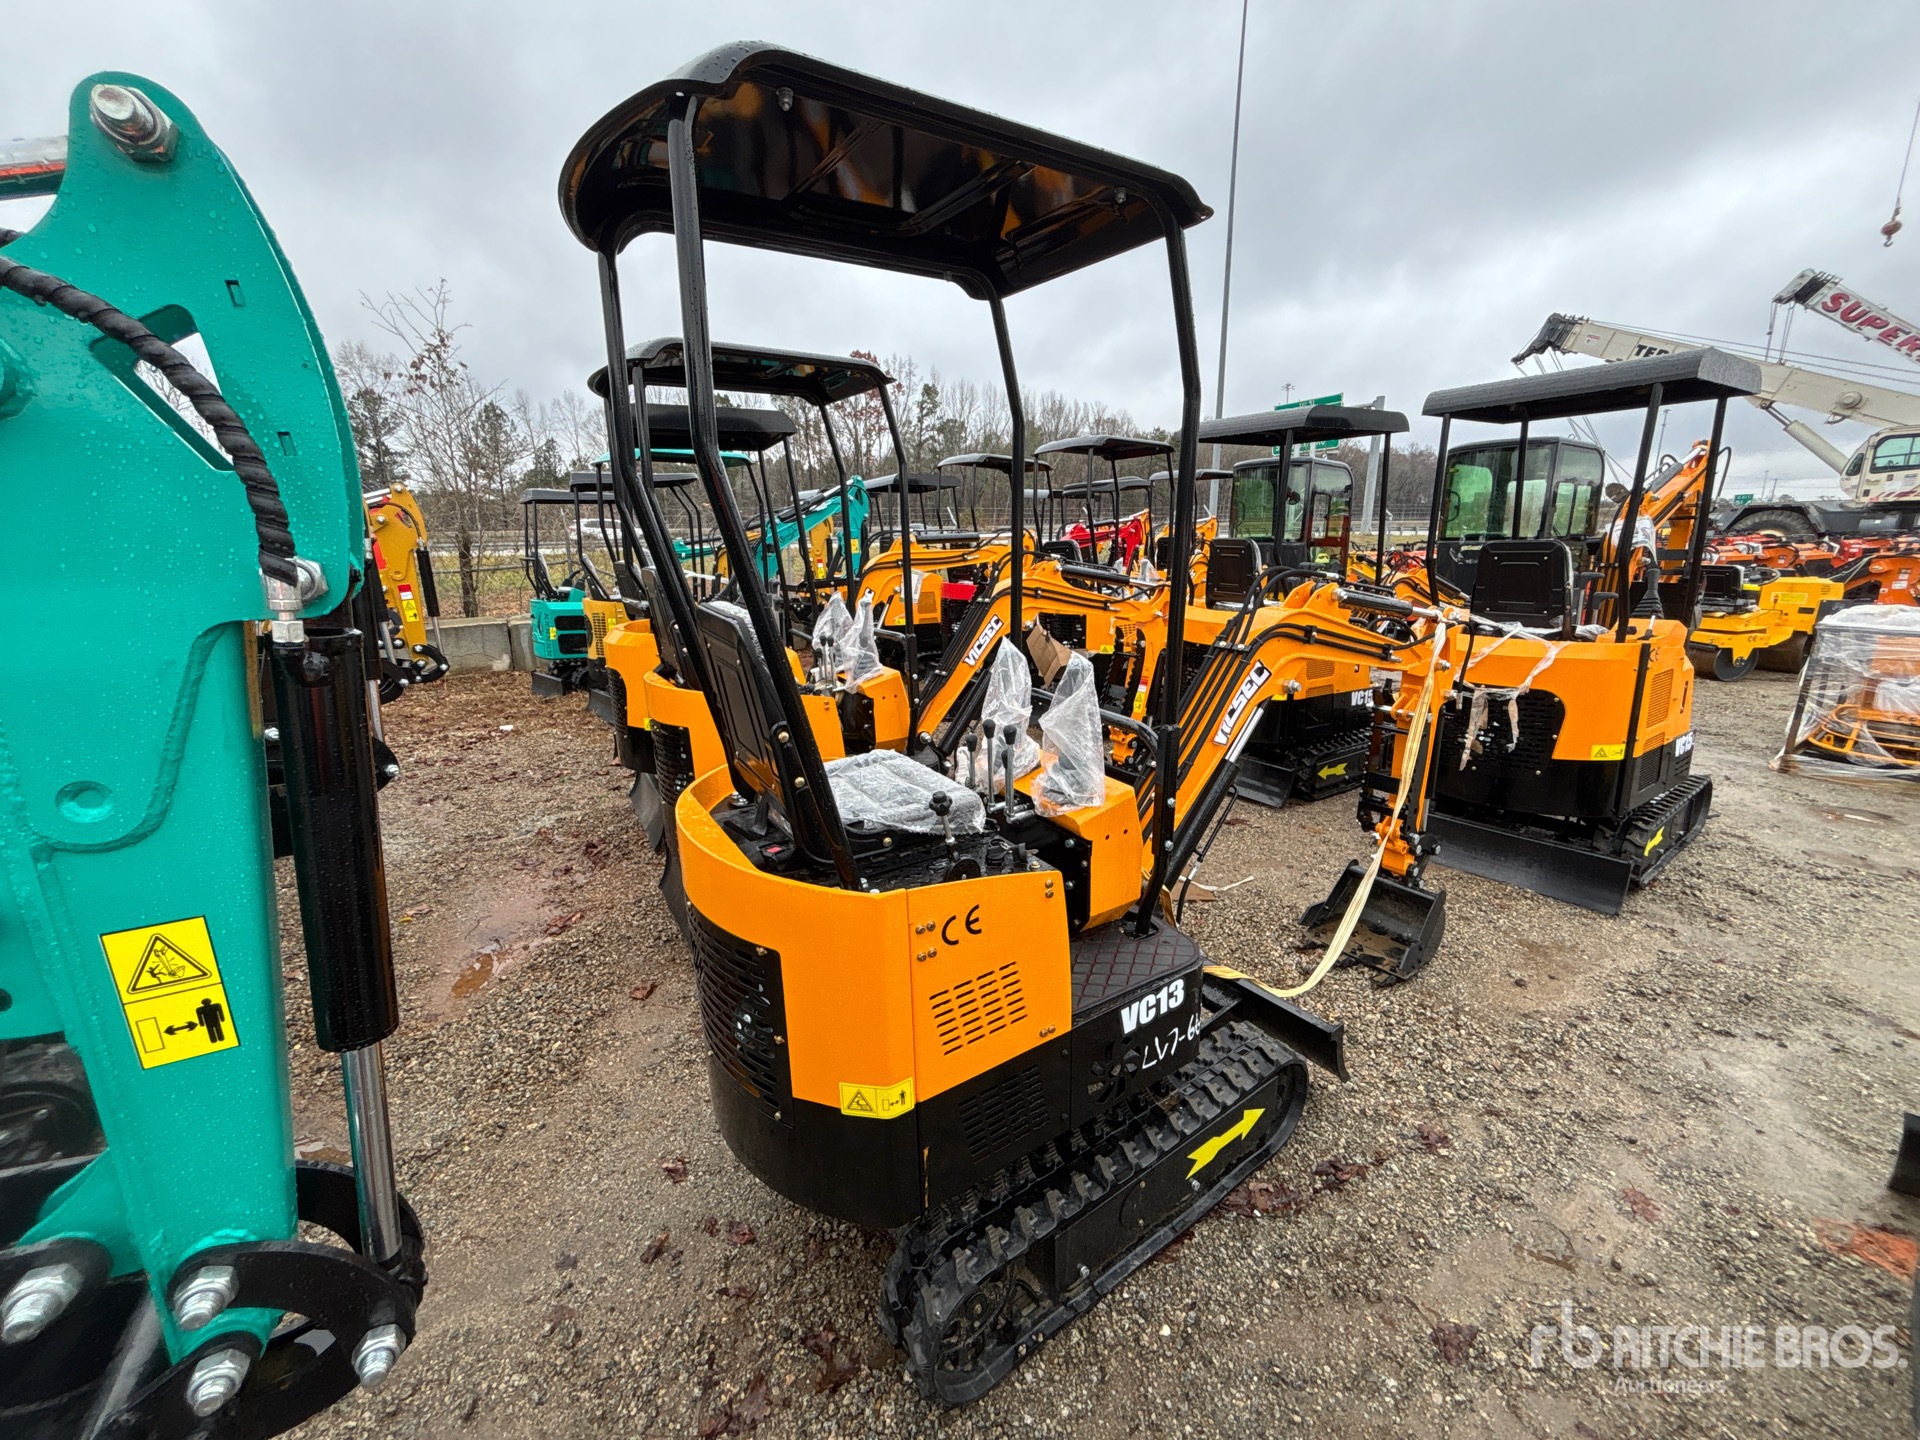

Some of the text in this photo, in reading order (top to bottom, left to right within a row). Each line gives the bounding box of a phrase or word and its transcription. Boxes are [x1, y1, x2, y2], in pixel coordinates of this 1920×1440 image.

[962, 613, 1004, 667] VICSEC
[1212, 659, 1272, 746] VICSEC
[1351, 689, 1374, 706] VC15
[941, 903, 983, 946] CE
[1120, 978, 1185, 1035] VC13
